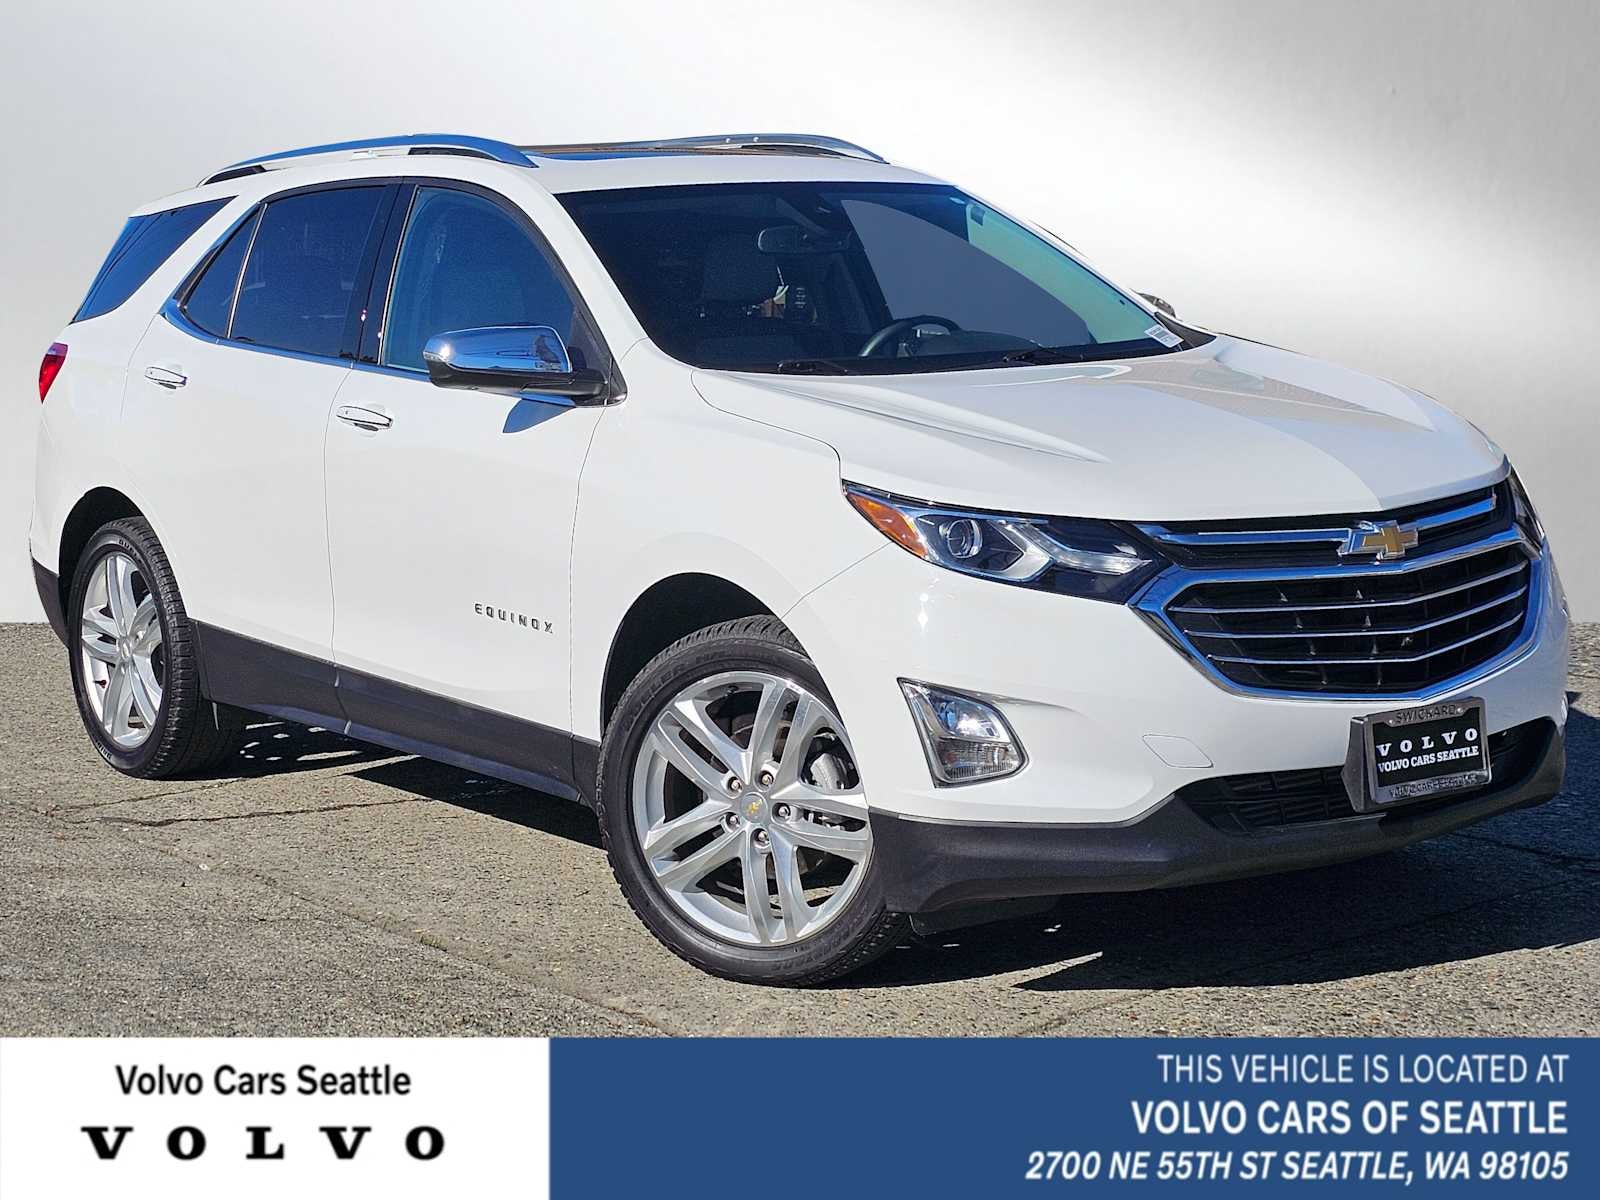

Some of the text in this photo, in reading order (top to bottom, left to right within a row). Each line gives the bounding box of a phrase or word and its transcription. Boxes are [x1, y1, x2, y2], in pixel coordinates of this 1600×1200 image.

[474, 603, 553, 633] EQUINOX
[1396, 705, 1456, 724] SWICKARD
[1376, 728, 1478, 756] VOLVO
[1377, 745, 1479, 773] VOLVO CARS SEATTLE
